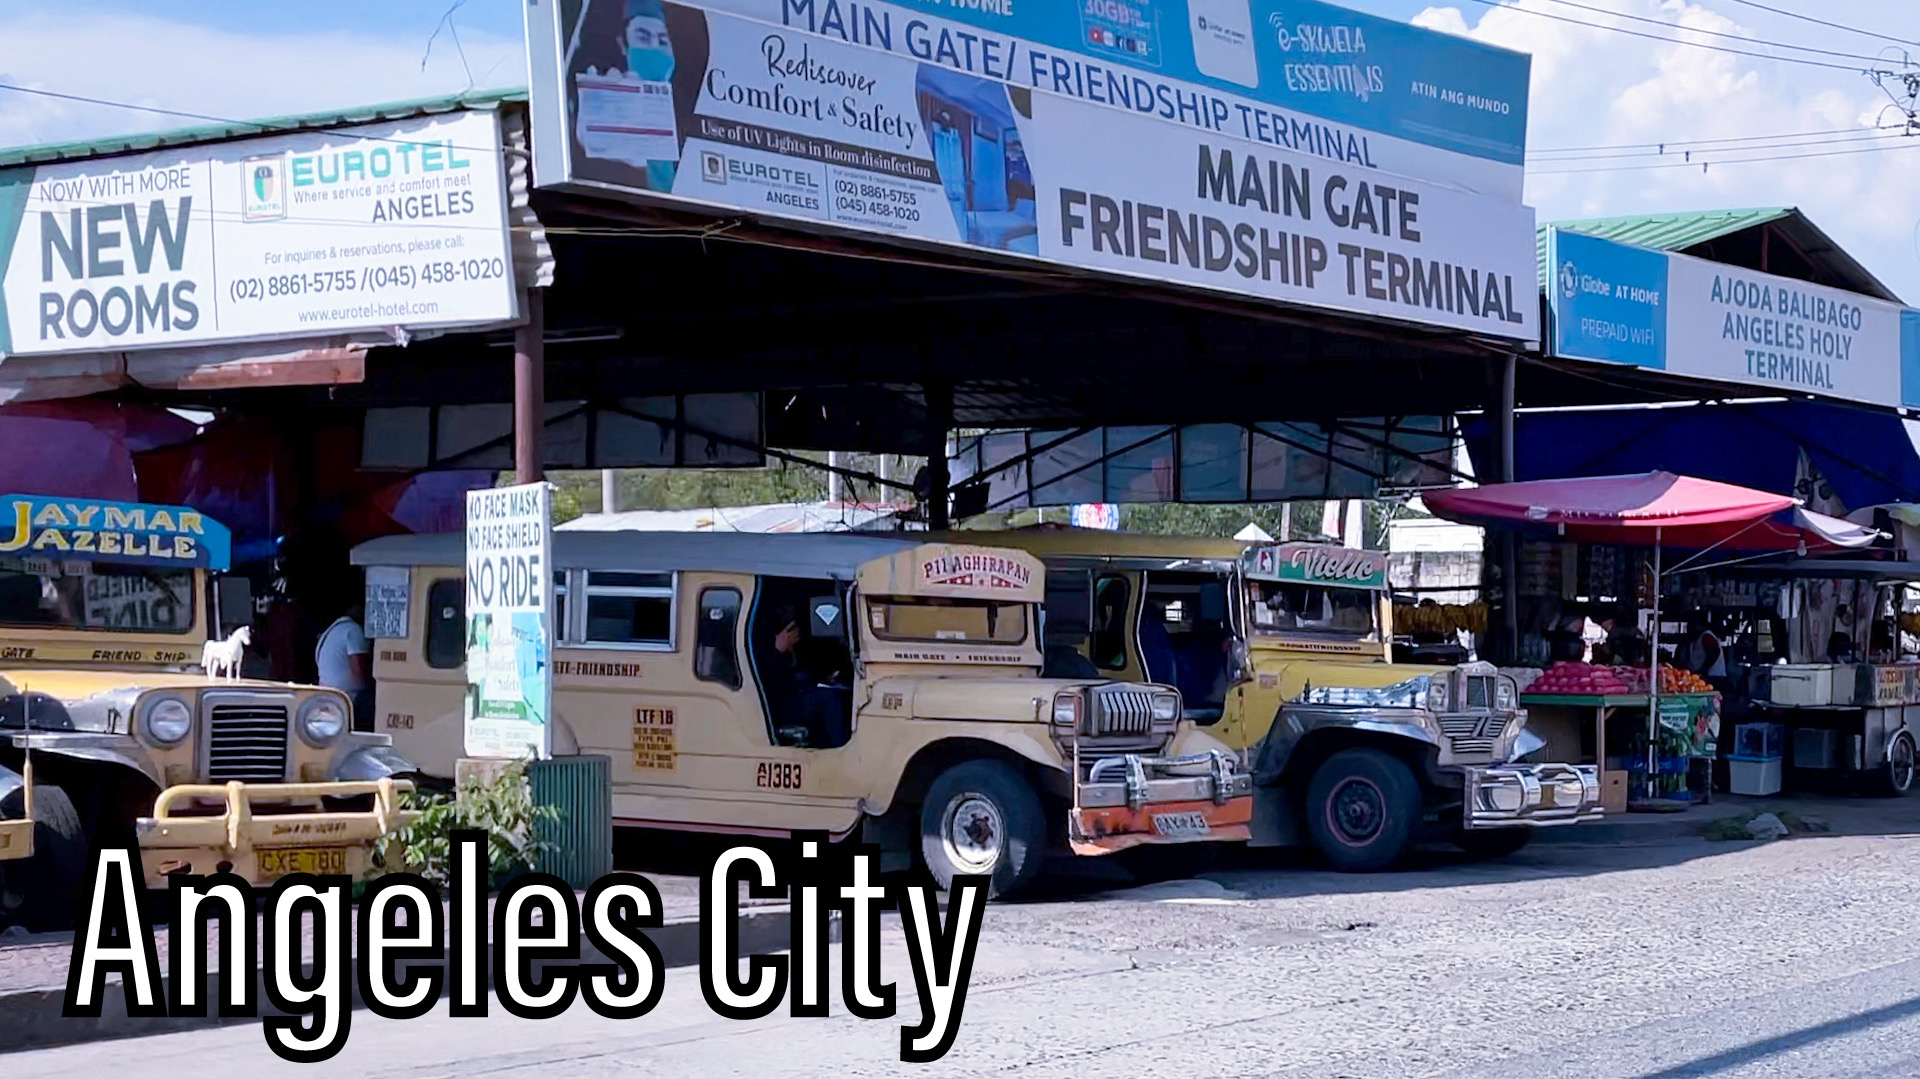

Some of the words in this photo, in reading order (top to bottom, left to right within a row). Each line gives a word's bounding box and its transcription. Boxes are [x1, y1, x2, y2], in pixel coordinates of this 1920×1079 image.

[761, 34, 877, 95] Rediscover
[782, 0, 893, 51] MAIN
[1028, 50, 1229, 132] FRIENDSHIP
[1235, 103, 1378, 169] TERMINAL
[1411, 81, 1437, 98] ATIN
[1440, 87, 1465, 106] ANG
[1467, 94, 1510, 116] MUNDO
[706, 68, 824, 121] Comfort
[828, 104, 838, 118] &
[842, 99, 918, 150] Safety
[291, 139, 471, 186] EUROTEL
[727, 124, 742, 142] of
[744, 128, 764, 146] UV
[766, 132, 806, 157] Lights
[809, 141, 822, 157] in
[824, 143, 859, 165] Room
[861, 150, 932, 178] disinfection
[39, 178, 83, 202] NOW
[87, 173, 135, 198] WITH
[139, 167, 191, 191] MORE
[294, 188, 328, 204] Where
[332, 185, 372, 200] service
[375, 181, 397, 195] and
[399, 177, 443, 193] comfort
[446, 173, 471, 188] meet
[728, 159, 819, 188] EUROTEL
[372, 191, 475, 223] ANGELES
[766, 191, 819, 211] ANGELES
[834, 179, 858, 198] (02)
[860, 182, 918, 206] 8861-5755
[835, 195, 867, 215] (045)
[869, 203, 920, 222] 458-1020
[1198, 143, 1311, 221] MAIN
[1323, 174, 1421, 244] GATE
[40, 196, 192, 283] NEW
[264, 251, 282, 265] For
[285, 246, 327, 266] inquiries
[329, 246, 338, 260] &
[340, 240, 405, 258] reservations,
[408, 237, 441, 255] please
[443, 234, 465, 250] call:
[1059, 187, 1328, 290] FRIENDSHIP
[1337, 242, 1524, 325] TERMINAL
[230, 278, 264, 303] (02)
[268, 269, 356, 296] 8861-5755
[421, 257, 504, 283] 458-1020
[1581, 275, 1610, 297] Globe
[1615, 285, 1629, 301] AT
[1631, 287, 1660, 306] HOME
[39, 280, 199, 340] ROOMS
[298, 299, 439, 323] www.eurotel-hotel.com
[1710, 275, 1773, 313] AJODA
[1778, 288, 1862, 331] BALIBAGO
[1581, 317, 1628, 342] PREPAID
[1722, 311, 1806, 351] ANGELES
[1810, 329, 1853, 361] HOLY
[1745, 349, 1834, 390] TERMINAL
[484, 493, 507, 519] FACE
[509, 489, 539, 517] MASK
[468, 526, 480, 550] NO
[482, 523, 503, 551] FACE
[506, 522, 541, 549] SHIELD
[468, 557, 495, 607] NO
[500, 554, 541, 607] RIDE
[1, 647, 36, 660] GATE
[92, 650, 142, 661] FRIEND
[154, 651, 186, 662] SHIP
[768, 763, 802, 789] 1383
[262, 851, 302, 872] CXE
